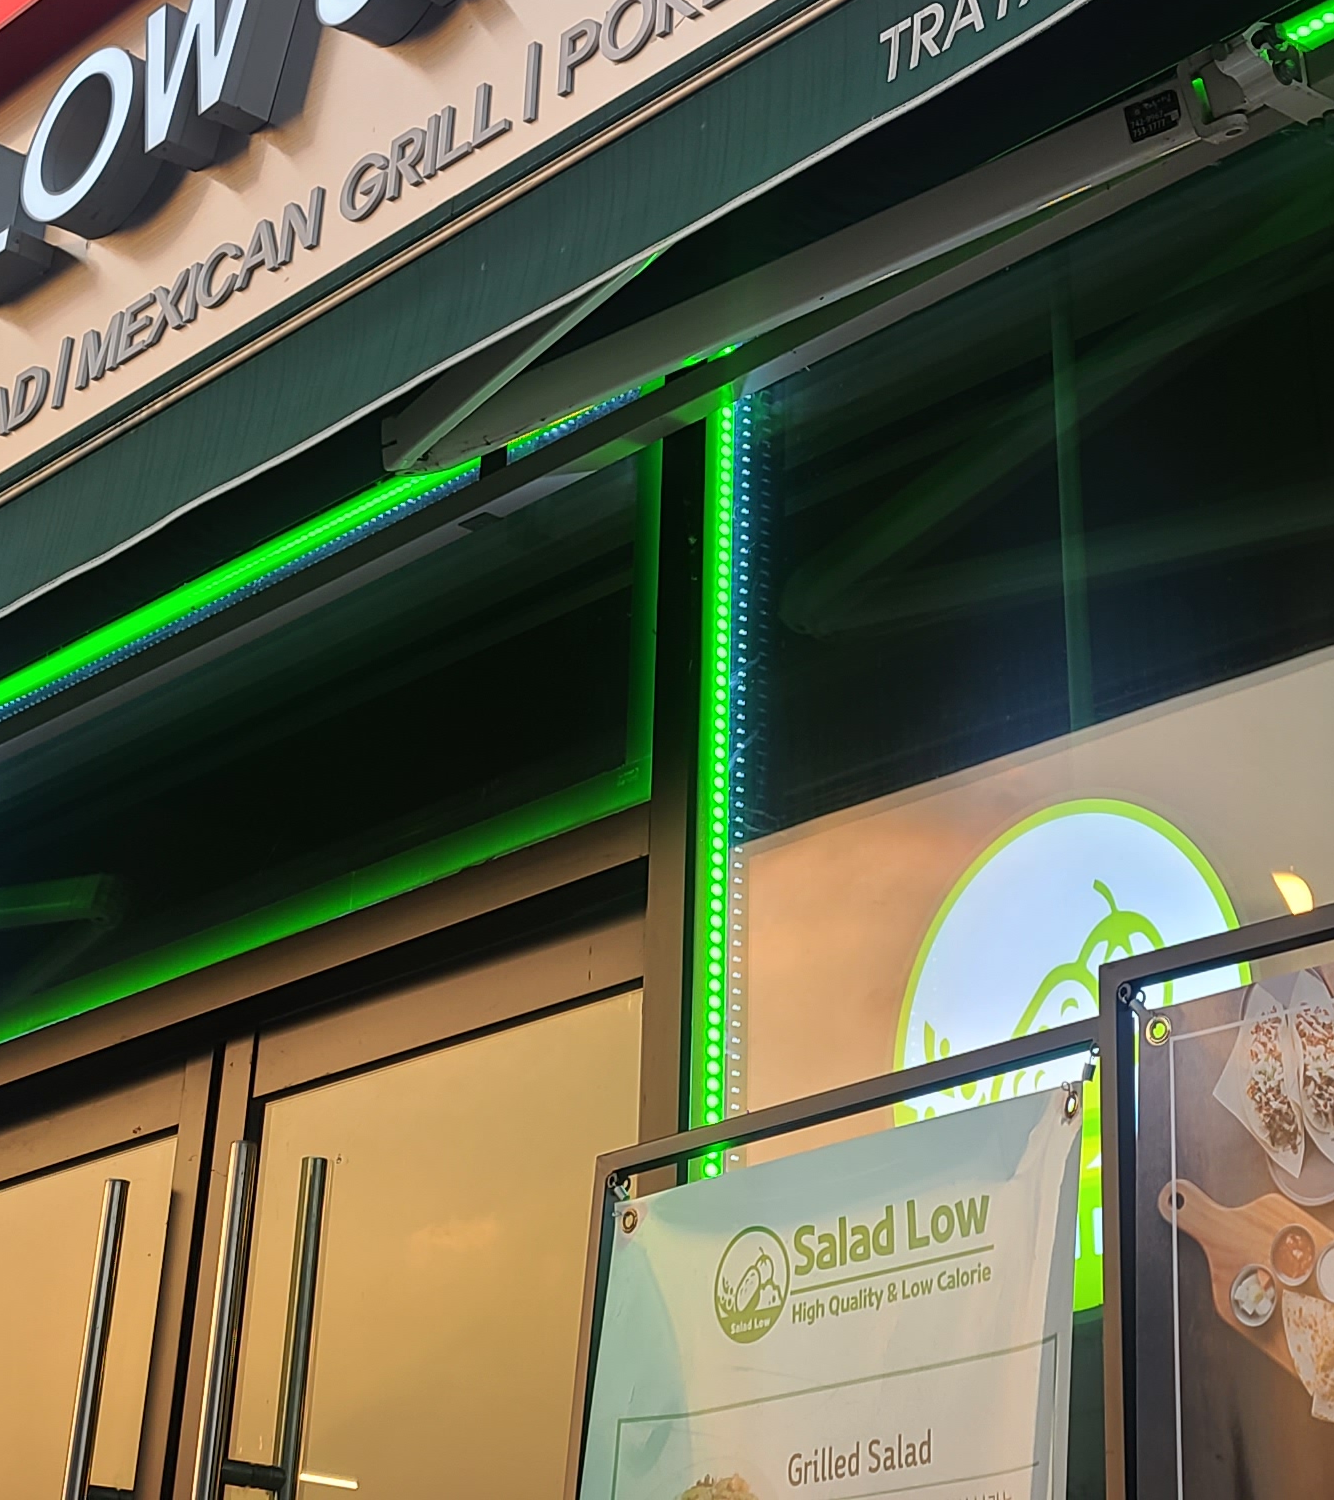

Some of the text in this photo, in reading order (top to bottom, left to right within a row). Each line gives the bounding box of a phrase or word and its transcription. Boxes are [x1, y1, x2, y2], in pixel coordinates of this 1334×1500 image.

[74, 186, 326, 391] MEXICAN
[339, 82, 513, 222] GRILL
[793, 1194, 990, 1277] Salad Low
[792, 1262, 992, 1326] High Quality & Low Calorie
[730, 1318, 753, 1335] Salad
[787, 1428, 933, 1488] Grilled Salad
